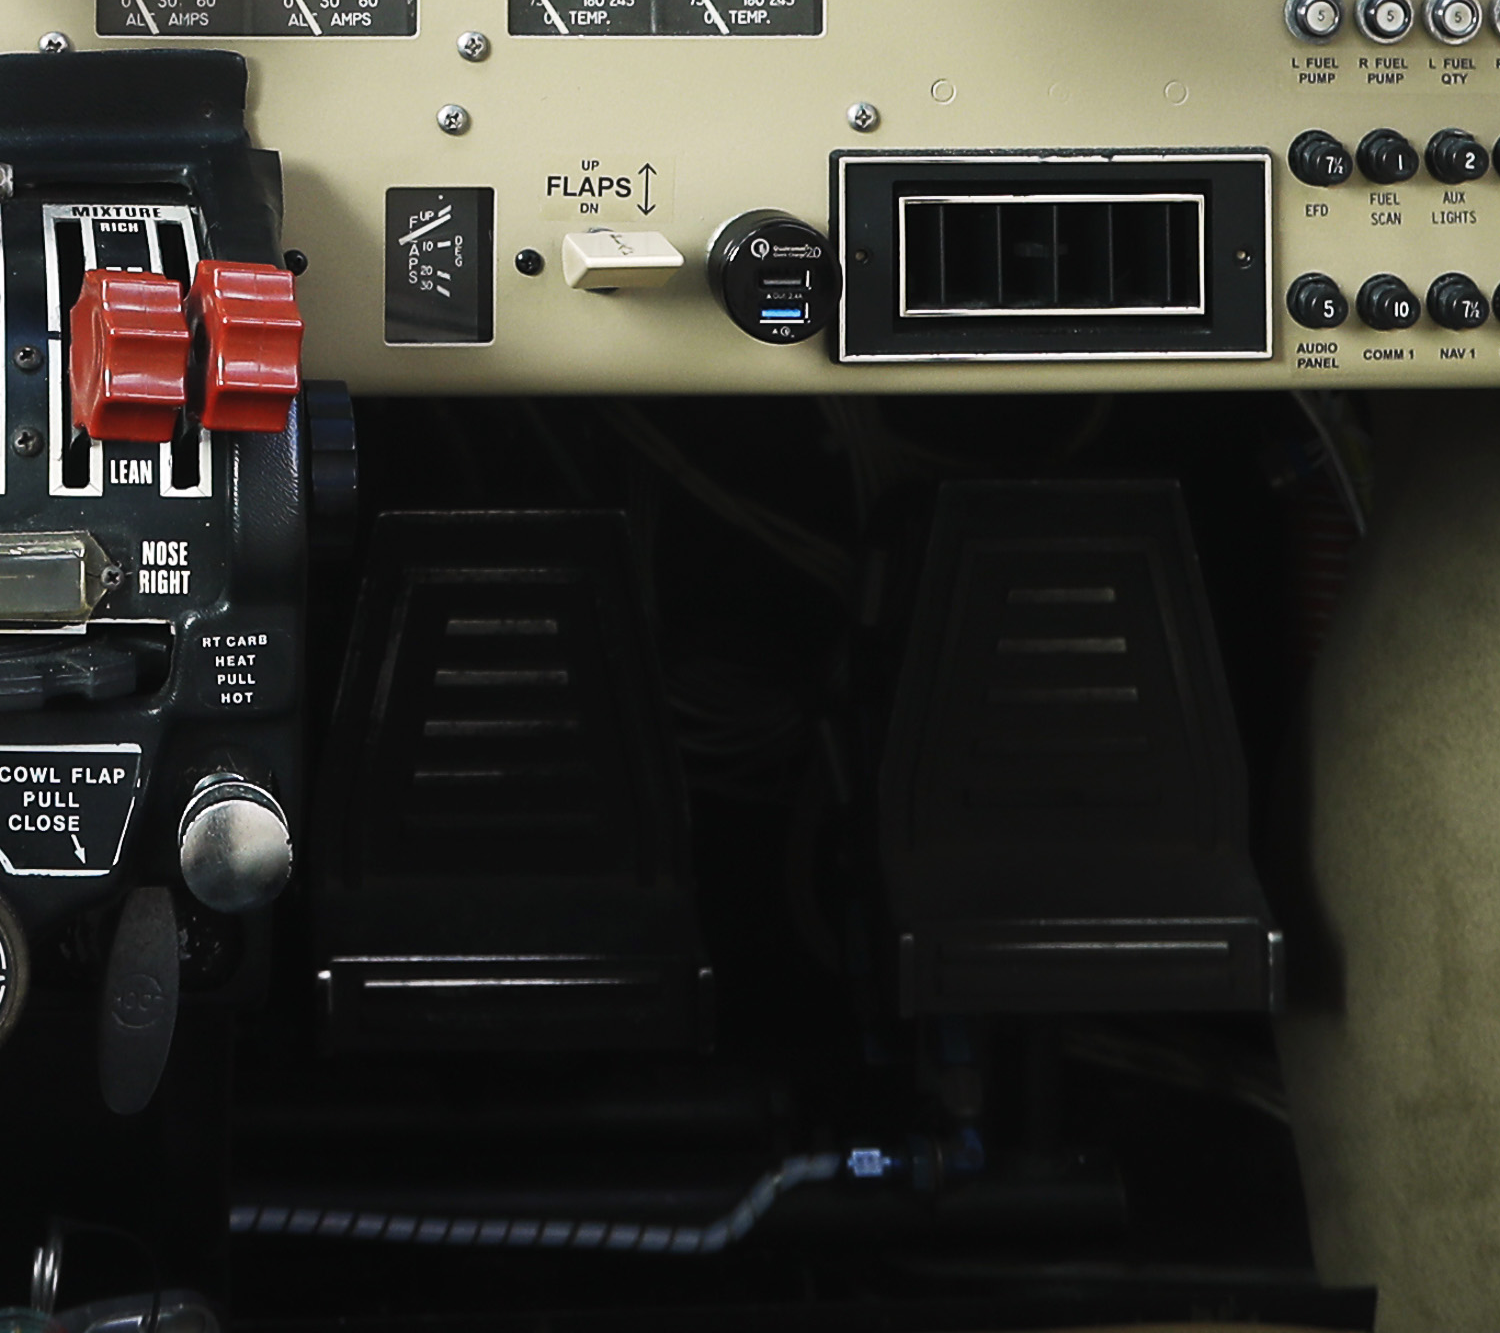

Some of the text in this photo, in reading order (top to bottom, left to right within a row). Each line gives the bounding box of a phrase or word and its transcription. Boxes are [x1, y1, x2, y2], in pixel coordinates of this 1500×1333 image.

[169, 13, 209, 26] AMPS
[581, 161, 600, 171] UP
[547, 176, 632, 198] FLAPS
[580, 203, 599, 214] DN
[1305, 204, 1328, 217] EFD
[1297, 342, 1337, 353] AUDIO
[1298, 357, 1338, 368] PANEL
[110, 460, 152, 484] LEAN
[141, 542, 189, 567] NOSE
[140, 568, 191, 595] RIGHT
[72, 767, 126, 785] FLAP
[23, 791, 79, 808] PULL
[8, 814, 80, 832] CLOSE
